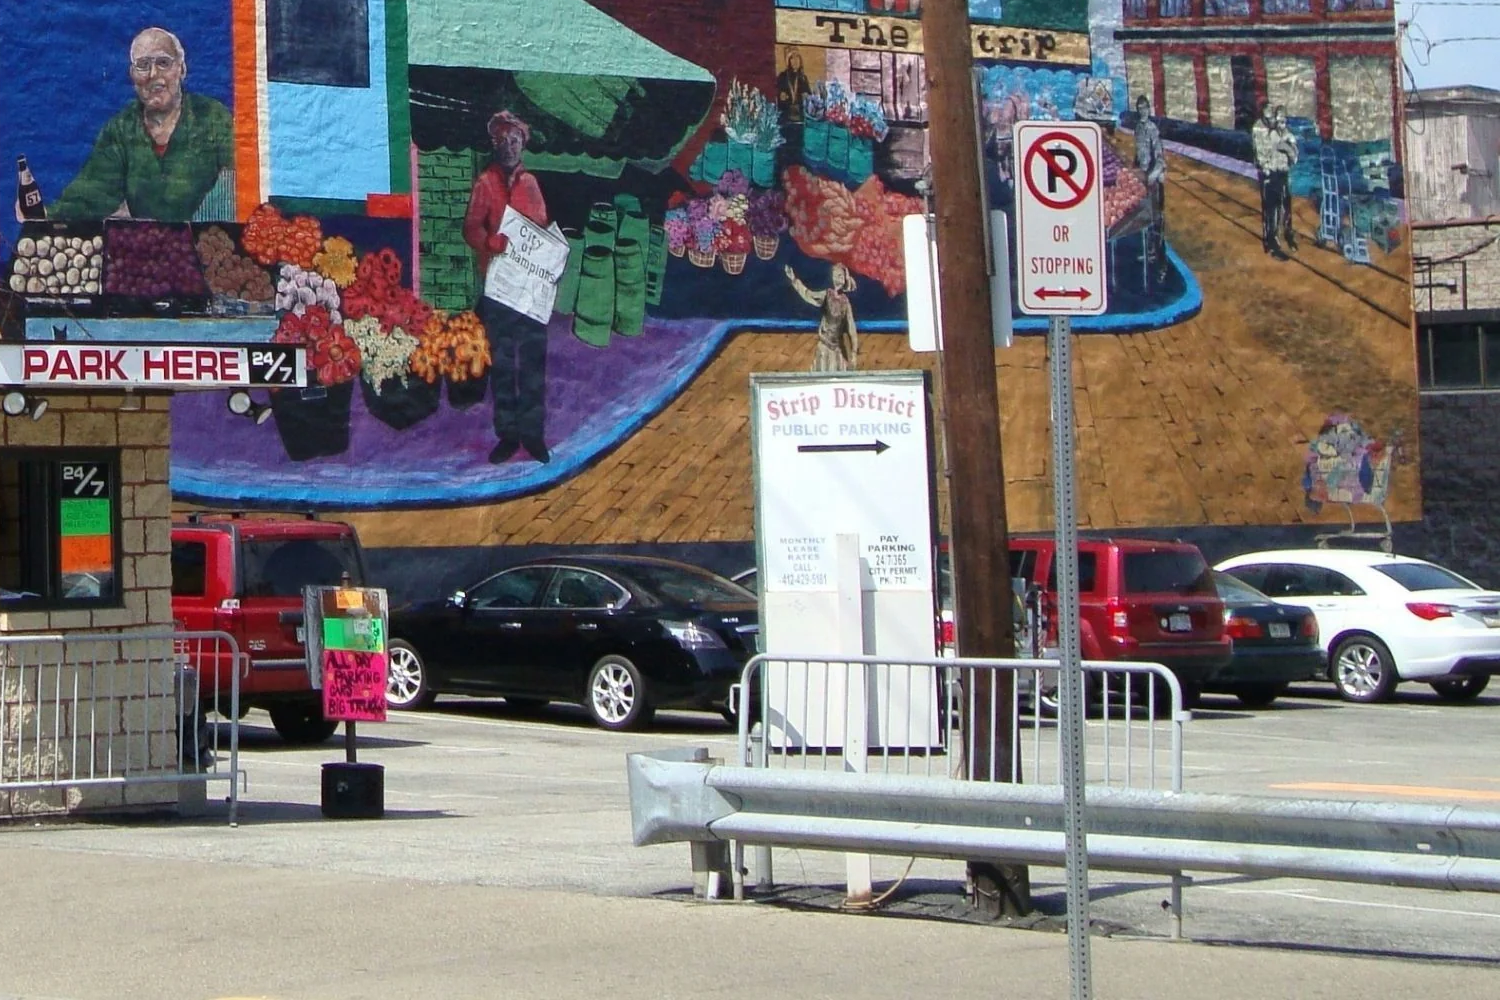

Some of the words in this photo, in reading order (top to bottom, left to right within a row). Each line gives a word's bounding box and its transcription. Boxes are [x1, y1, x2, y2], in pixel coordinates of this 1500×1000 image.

[816, 15, 909, 47] The
[977, 30, 1056, 60] trip
[27, 193, 39, 205] 57
[520, 225, 544, 250] City
[1053, 225, 1069, 242] OR
[1031, 257, 1093, 274] STOPPING
[24, 349, 128, 380] PARK
[144, 350, 240, 381] HERE
[252, 351, 293, 382] 24/7
[767, 392, 820, 420] Strip
[833, 387, 916, 418] District
[772, 423, 829, 436] PUBLIC
[839, 422, 911, 435] PARKING
[63, 466, 105, 496] 24/7
[868, 544, 916, 552] PARKING
[793, 563, 812, 572] CALL
[868, 567, 887, 576] CITY
[889, 566, 917, 575] PERMIT
[895, 576, 907, 584] 712
[327, 651, 351, 670] ALL
[334, 670, 381, 685] PARKING
